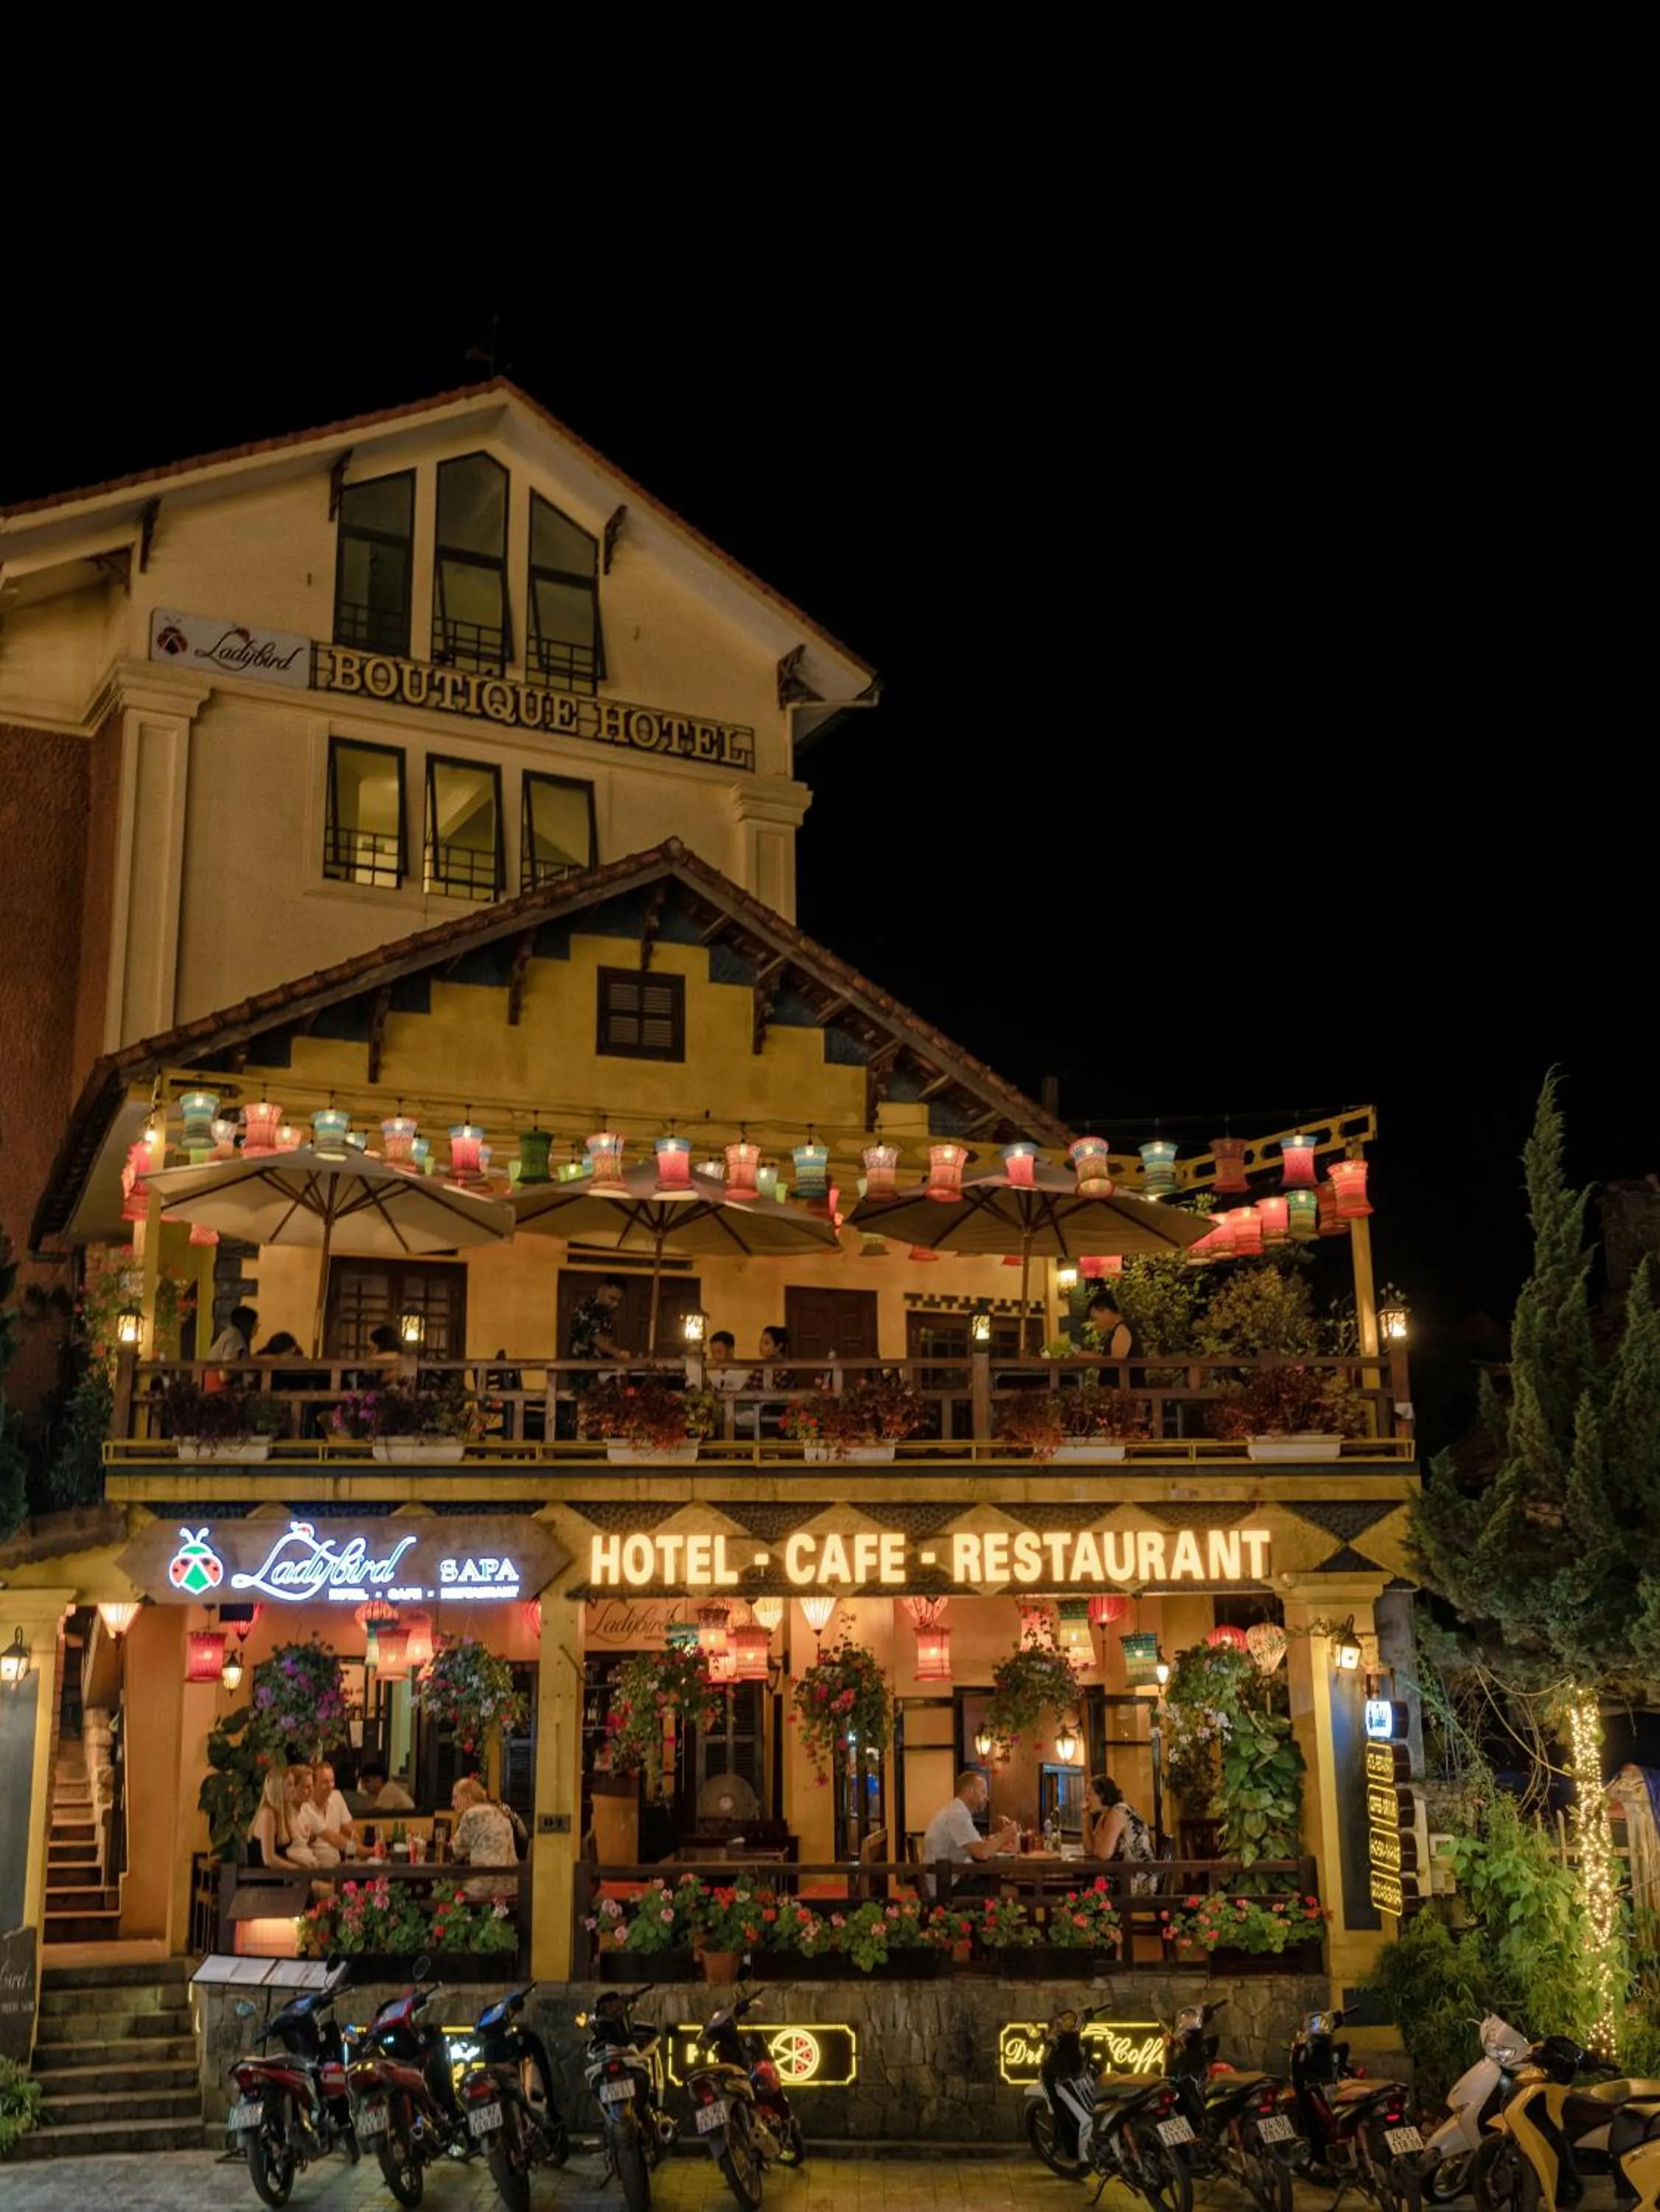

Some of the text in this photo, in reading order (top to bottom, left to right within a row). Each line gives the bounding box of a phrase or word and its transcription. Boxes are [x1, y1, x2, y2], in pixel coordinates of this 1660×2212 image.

[193, 630, 304, 672] Ladybird
[329, 649, 747, 766] BOUTIQUE HOTEL
[231, 1531, 417, 1601] Ladybird
[439, 1557, 520, 1582] SAPA
[590, 1533, 739, 1585] HOTEL
[784, 1532, 906, 1585] CAFE
[952, 1529, 1271, 1583] RESTAURANT
